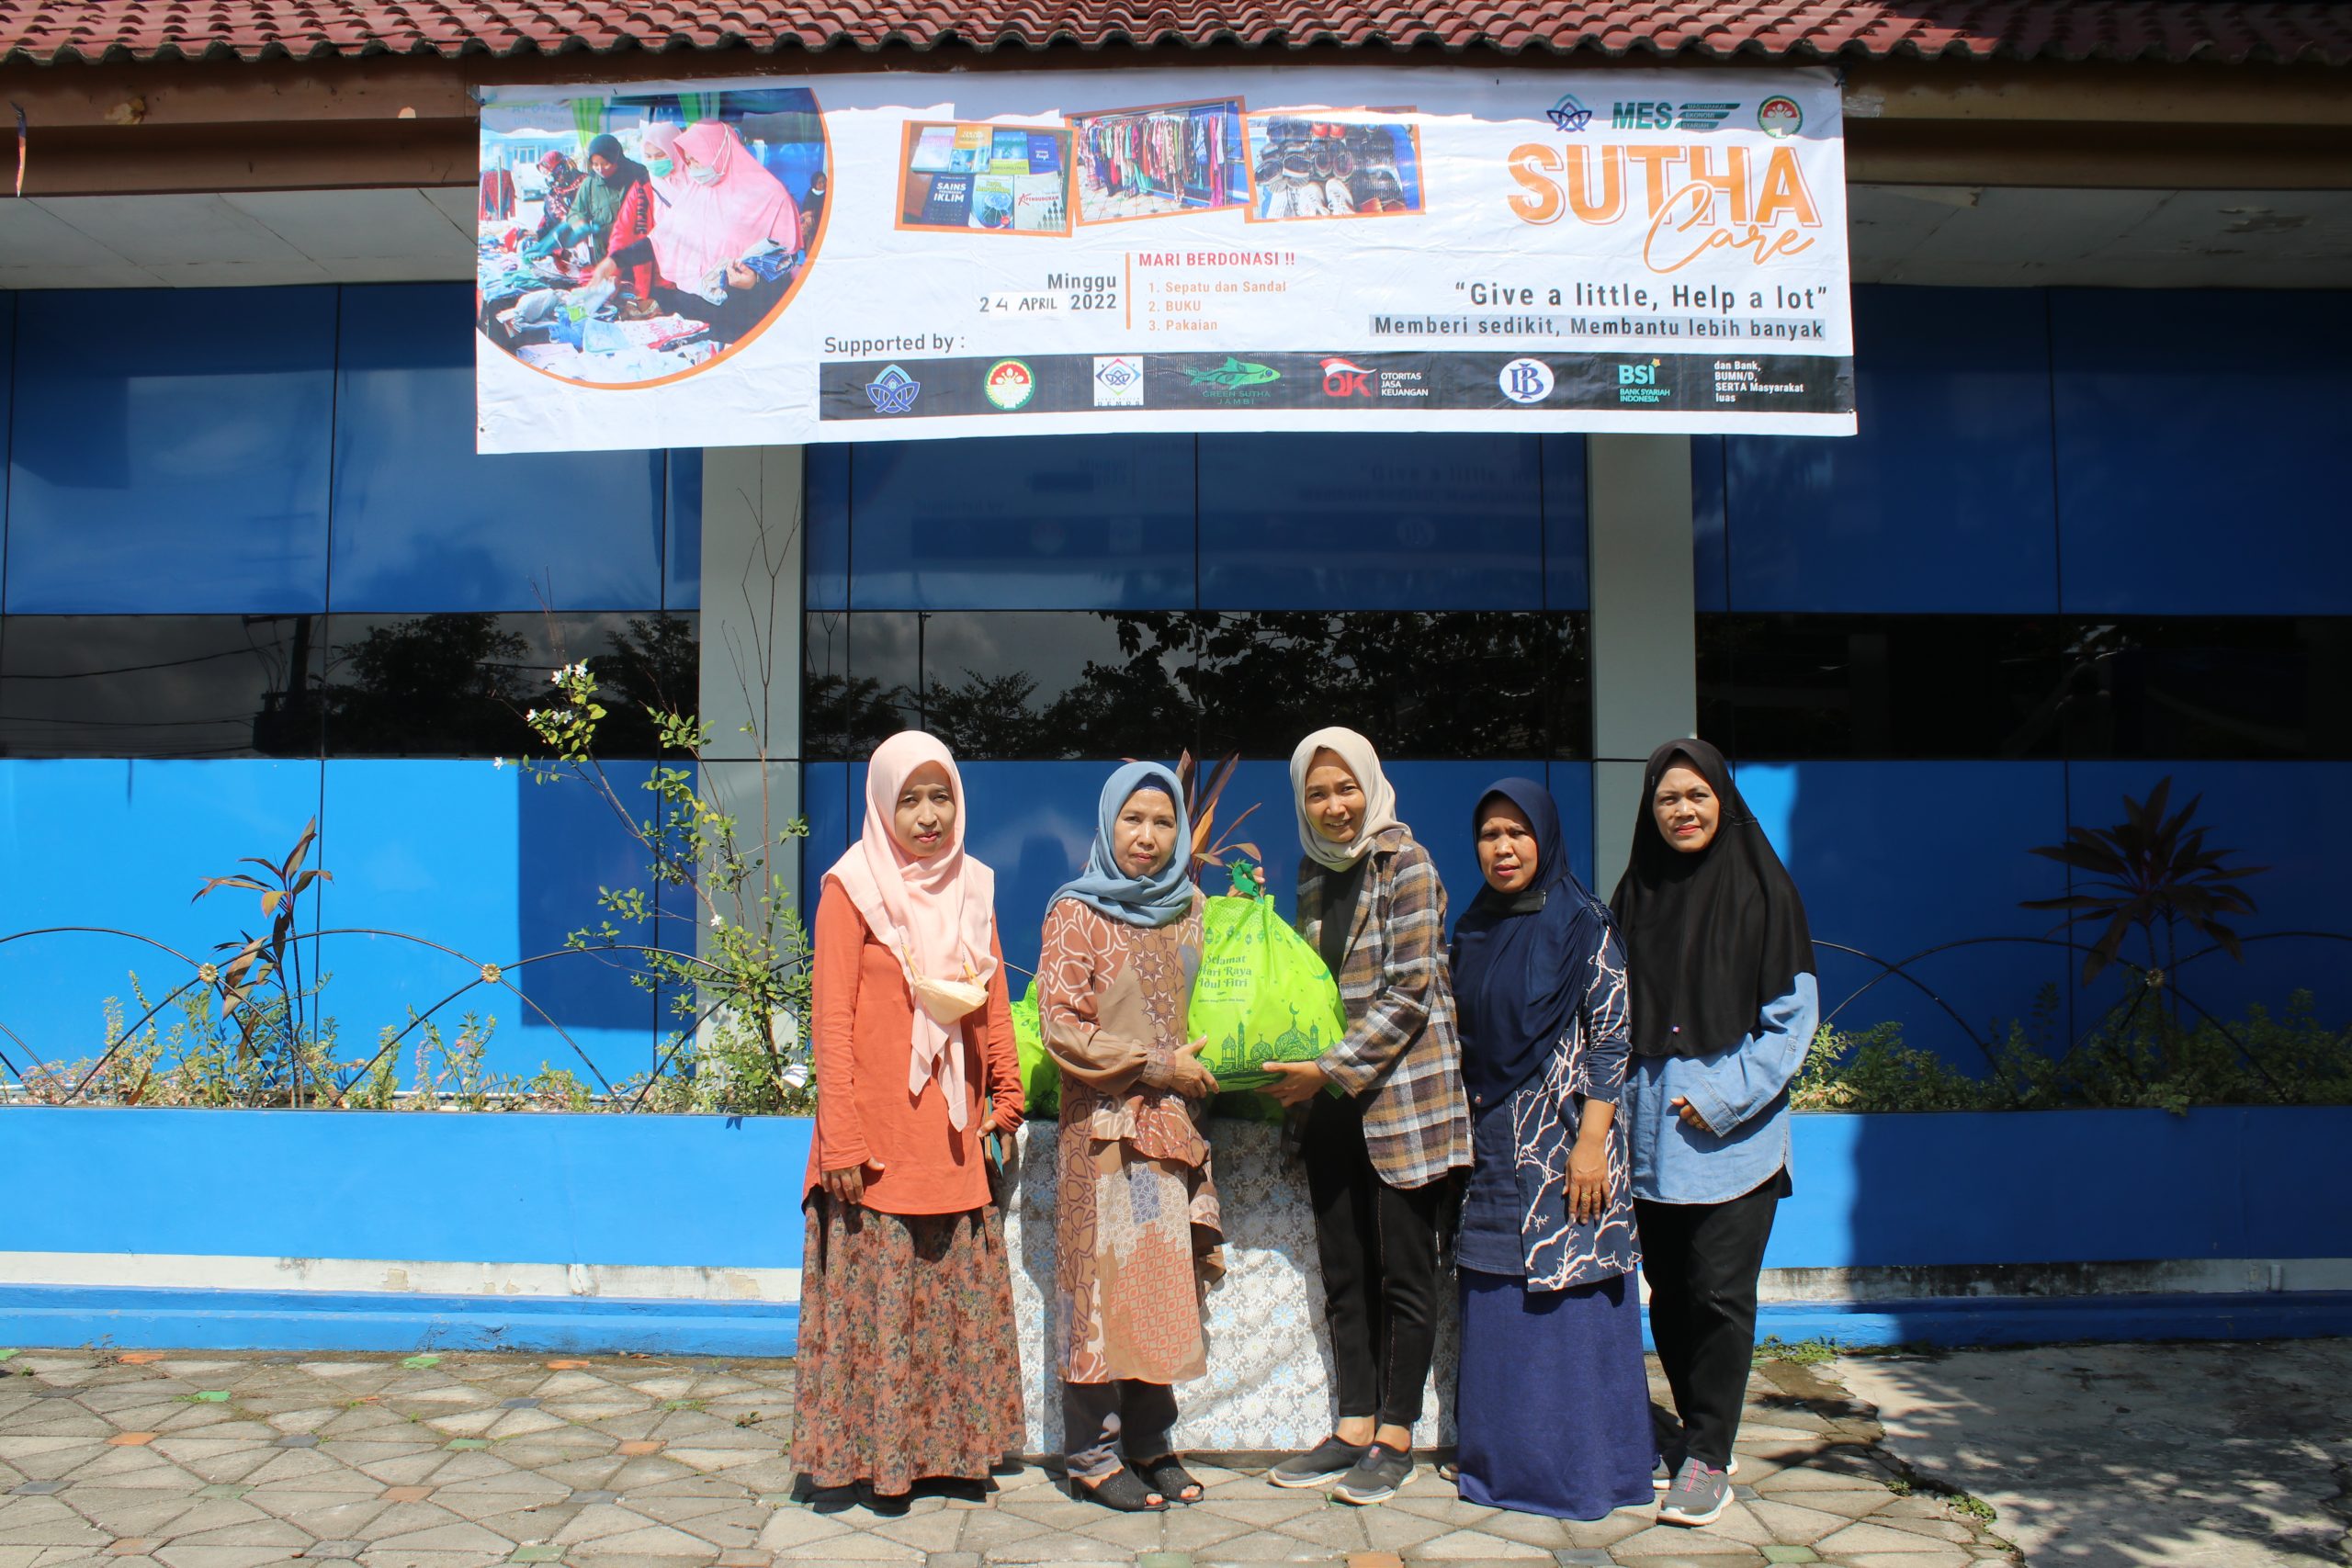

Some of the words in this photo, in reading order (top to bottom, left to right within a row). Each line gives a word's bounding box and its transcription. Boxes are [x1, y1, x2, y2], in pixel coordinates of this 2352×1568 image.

[1611, 102, 1673, 130] MES
[936, 183, 967, 191] SAINS
[1507, 143, 1823, 227] SUTHA
[933, 193, 965, 202] IKLIM
[1643, 180, 1815, 274] Care
[1138, 253, 1180, 266] MARI
[1186, 252, 1279, 266] BERDONASI
[1047, 274, 1117, 292] Minggu
[1148, 282, 1160, 293] 1.
[1165, 281, 1210, 295] Sepatu
[1215, 280, 1238, 292] dan
[1242, 279, 1286, 292] Sandal
[1018, 297, 1057, 311] APRIL
[1070, 293, 1117, 310] 2022
[1547, 288, 1562, 306] a
[1576, 283, 1658, 310] little,
[1672, 285, 1736, 314] Help
[1748, 290, 1763, 309] a
[1148, 300, 1160, 312] 2.
[1165, 299, 1201, 312] BUKU
[1148, 320, 1160, 331] 3.
[1166, 319, 1217, 331] Pakaian
[1374, 316, 1468, 335] Memberi
[1477, 316, 1560, 337] sedikit,
[1570, 317, 1680, 337] Membantu
[1689, 318, 1740, 337] lebih
[1750, 319, 1823, 341] banyak
[824, 333, 925, 356] Supported
[933, 333, 955, 352] by
[1714, 360, 1732, 370] dan
[1734, 360, 1761, 372] Bank,
[1381, 372, 1422, 380] OTORITAS
[1618, 364, 1655, 385] BSI
[1714, 371, 1758, 382] BUMN/D,
[1381, 380, 1402, 389] JASA
[1715, 382, 1747, 392] SERTA
[1749, 382, 1804, 394] Masyarakat
[1381, 388, 1429, 397] KEUANGAN
[1620, 388, 1640, 396] BANK
[1715, 393, 1736, 402] luas
[1620, 395, 1660, 403] INDONESIA
[1205, 953, 1246, 964] Selamat
[1224, 966, 1252, 976] Raya
